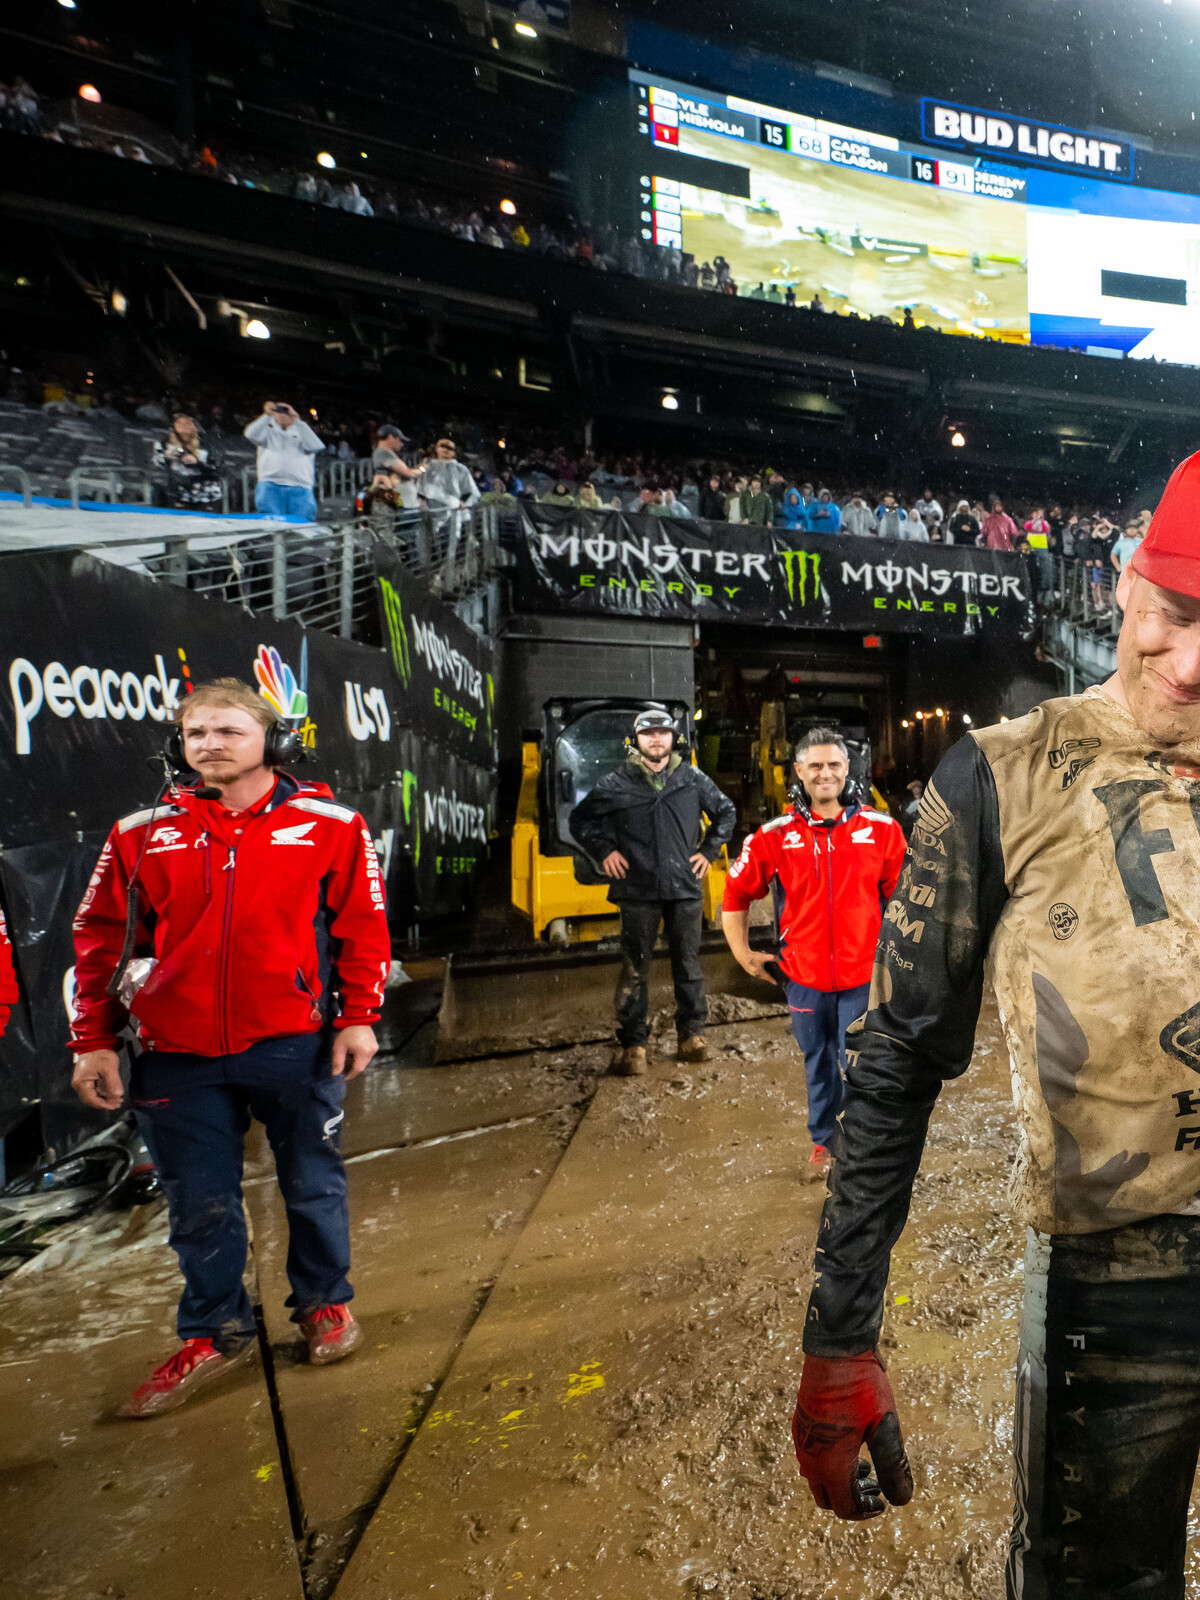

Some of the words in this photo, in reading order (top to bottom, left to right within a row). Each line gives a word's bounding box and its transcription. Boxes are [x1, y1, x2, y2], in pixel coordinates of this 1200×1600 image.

[677, 97, 710, 118] YLE
[679, 110, 745, 138] HISHOLM
[764, 123, 784, 146] 15
[799, 135, 823, 154] 68
[830, 138, 871, 158] CADE
[933, 106, 1014, 149] BUD
[1017, 124, 1122, 172] LIGHT
[830, 151, 889, 174] CLASON
[915, 160, 933, 182] 16
[946, 170, 967, 188] 91
[974, 170, 1027, 191] JEREMY
[975, 181, 1015, 200] HAND
[538, 533, 771, 581] MONSTER
[579, 574, 741, 598] ENERGY
[841, 560, 1027, 600] MONSTER
[873, 597, 1000, 617] ENERGY
[411, 613, 484, 709] MONSTER
[9, 654, 181, 755] peacock
[434, 687, 477, 732] ENERGY
[1048, 737, 1102, 770] WPS
[424, 785, 487, 845] MONSTER
[910, 822, 948, 857] NDA
[436, 856, 477, 874] EERGY
[1053, 911, 1073, 929] 25
